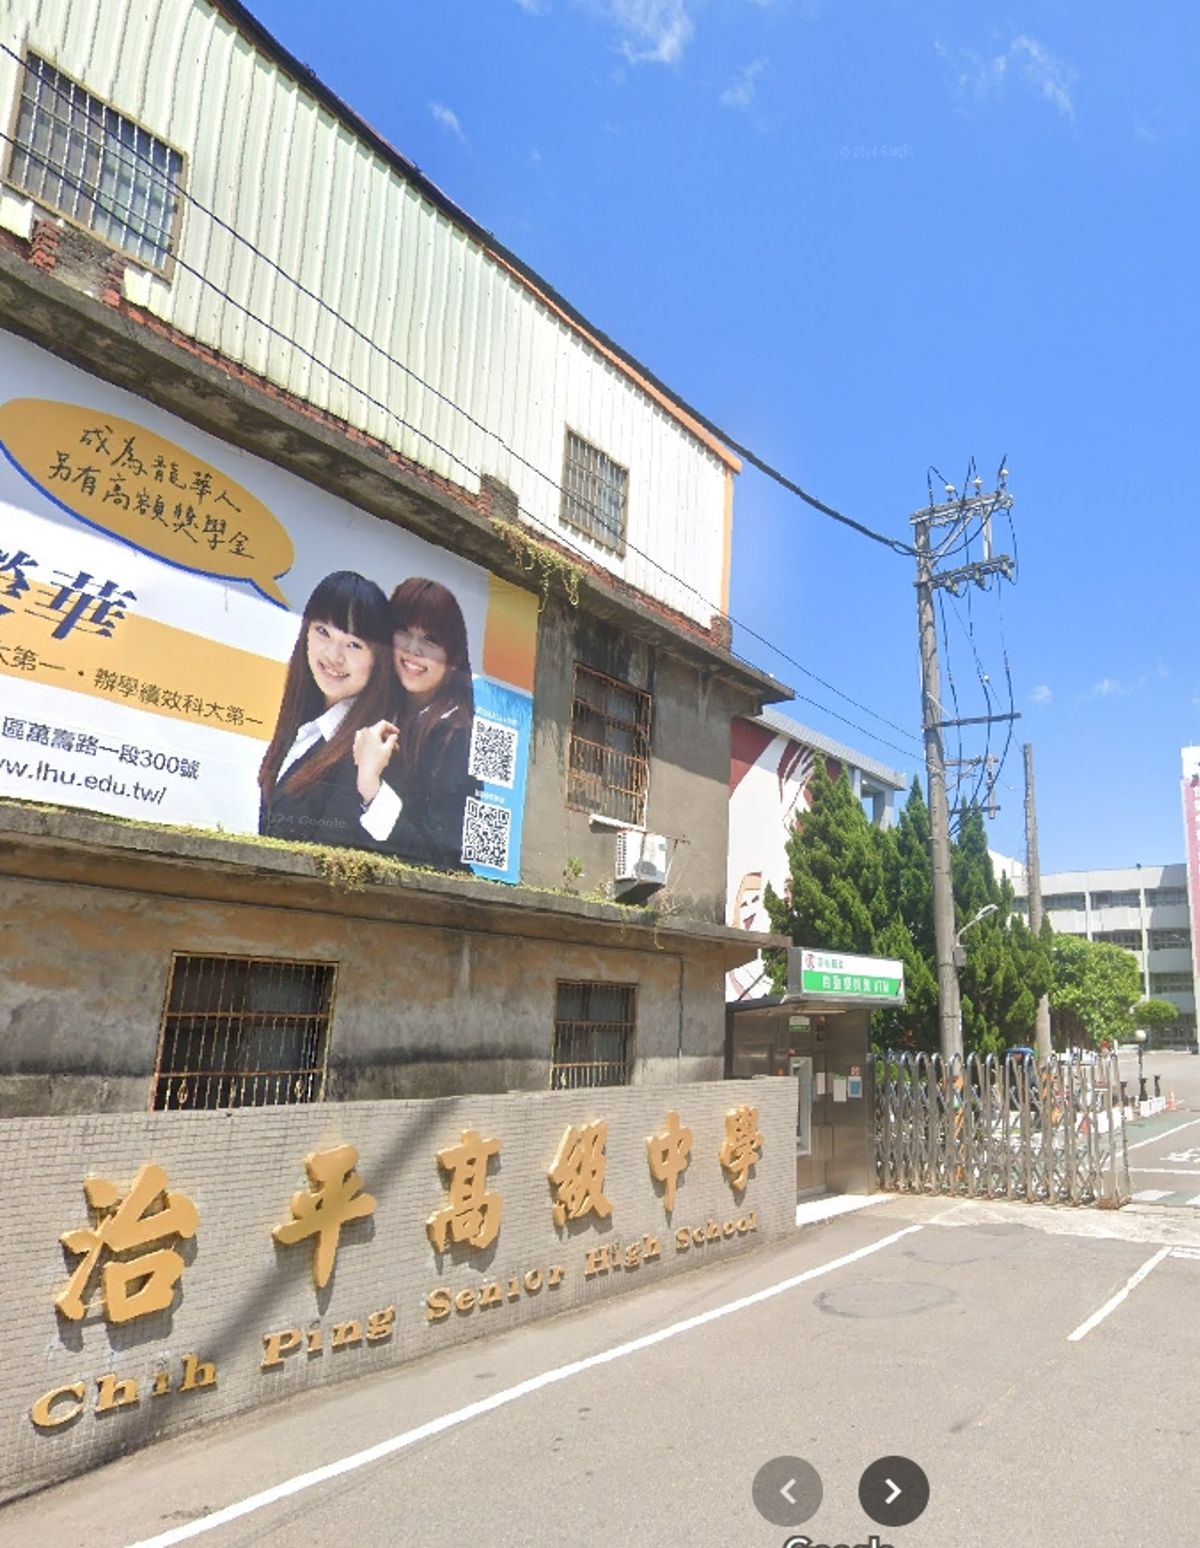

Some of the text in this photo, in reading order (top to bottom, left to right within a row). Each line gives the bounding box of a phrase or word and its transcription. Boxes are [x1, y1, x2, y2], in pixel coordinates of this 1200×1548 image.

[47, 449, 255, 560] 另有高額獎學金
[79, 424, 242, 513] 成為龍華人
[54, 1105, 765, 1324] 治平高級中學
[31, 1211, 758, 1429] Chih Ping Senior High School
